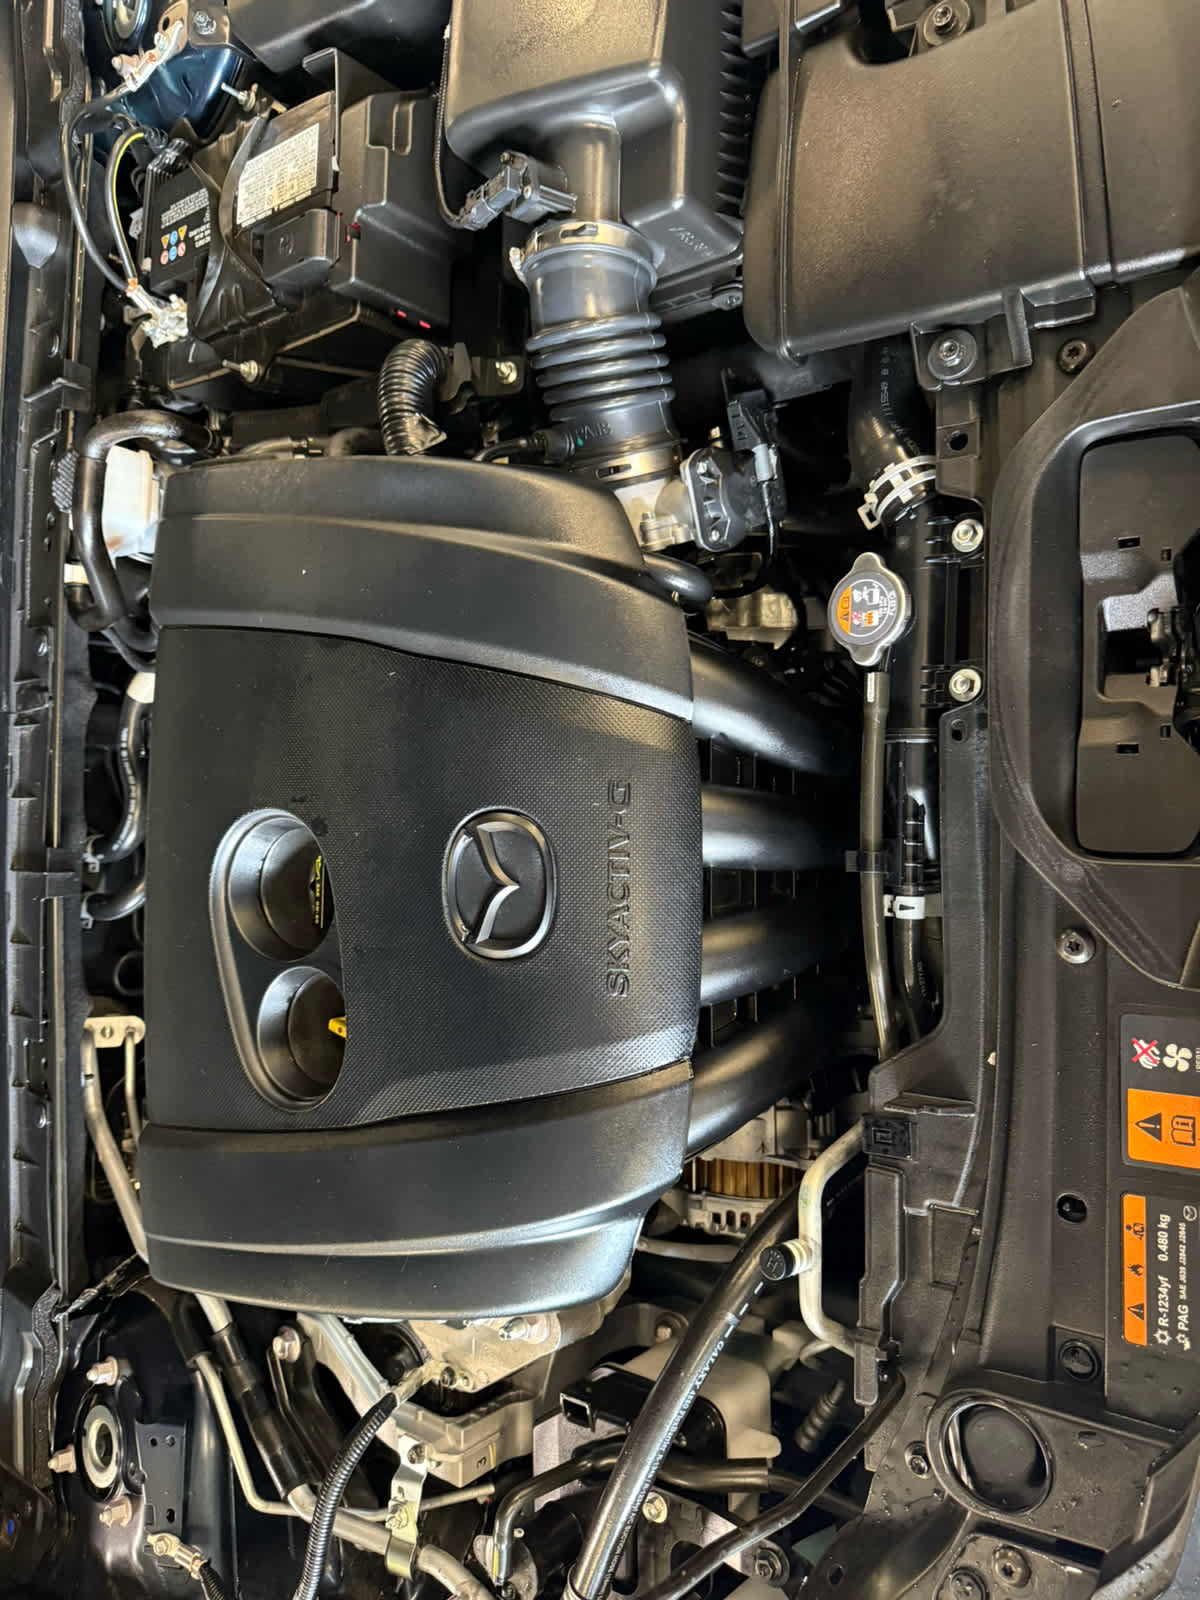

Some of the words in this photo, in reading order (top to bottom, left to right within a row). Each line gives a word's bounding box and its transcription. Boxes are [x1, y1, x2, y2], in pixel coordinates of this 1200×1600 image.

[606, 780, 631, 998] SKYACTIV-G
[1157, 1213, 1171, 1229] kg
[1157, 1231, 1169, 1262] 0.480
[1157, 1274, 1171, 1328] R-1234yf
[1179, 1285, 1187, 1300] SAE
[1177, 1304, 1189, 1331] PAG
[693, 1339, 725, 1389] GALAXY
